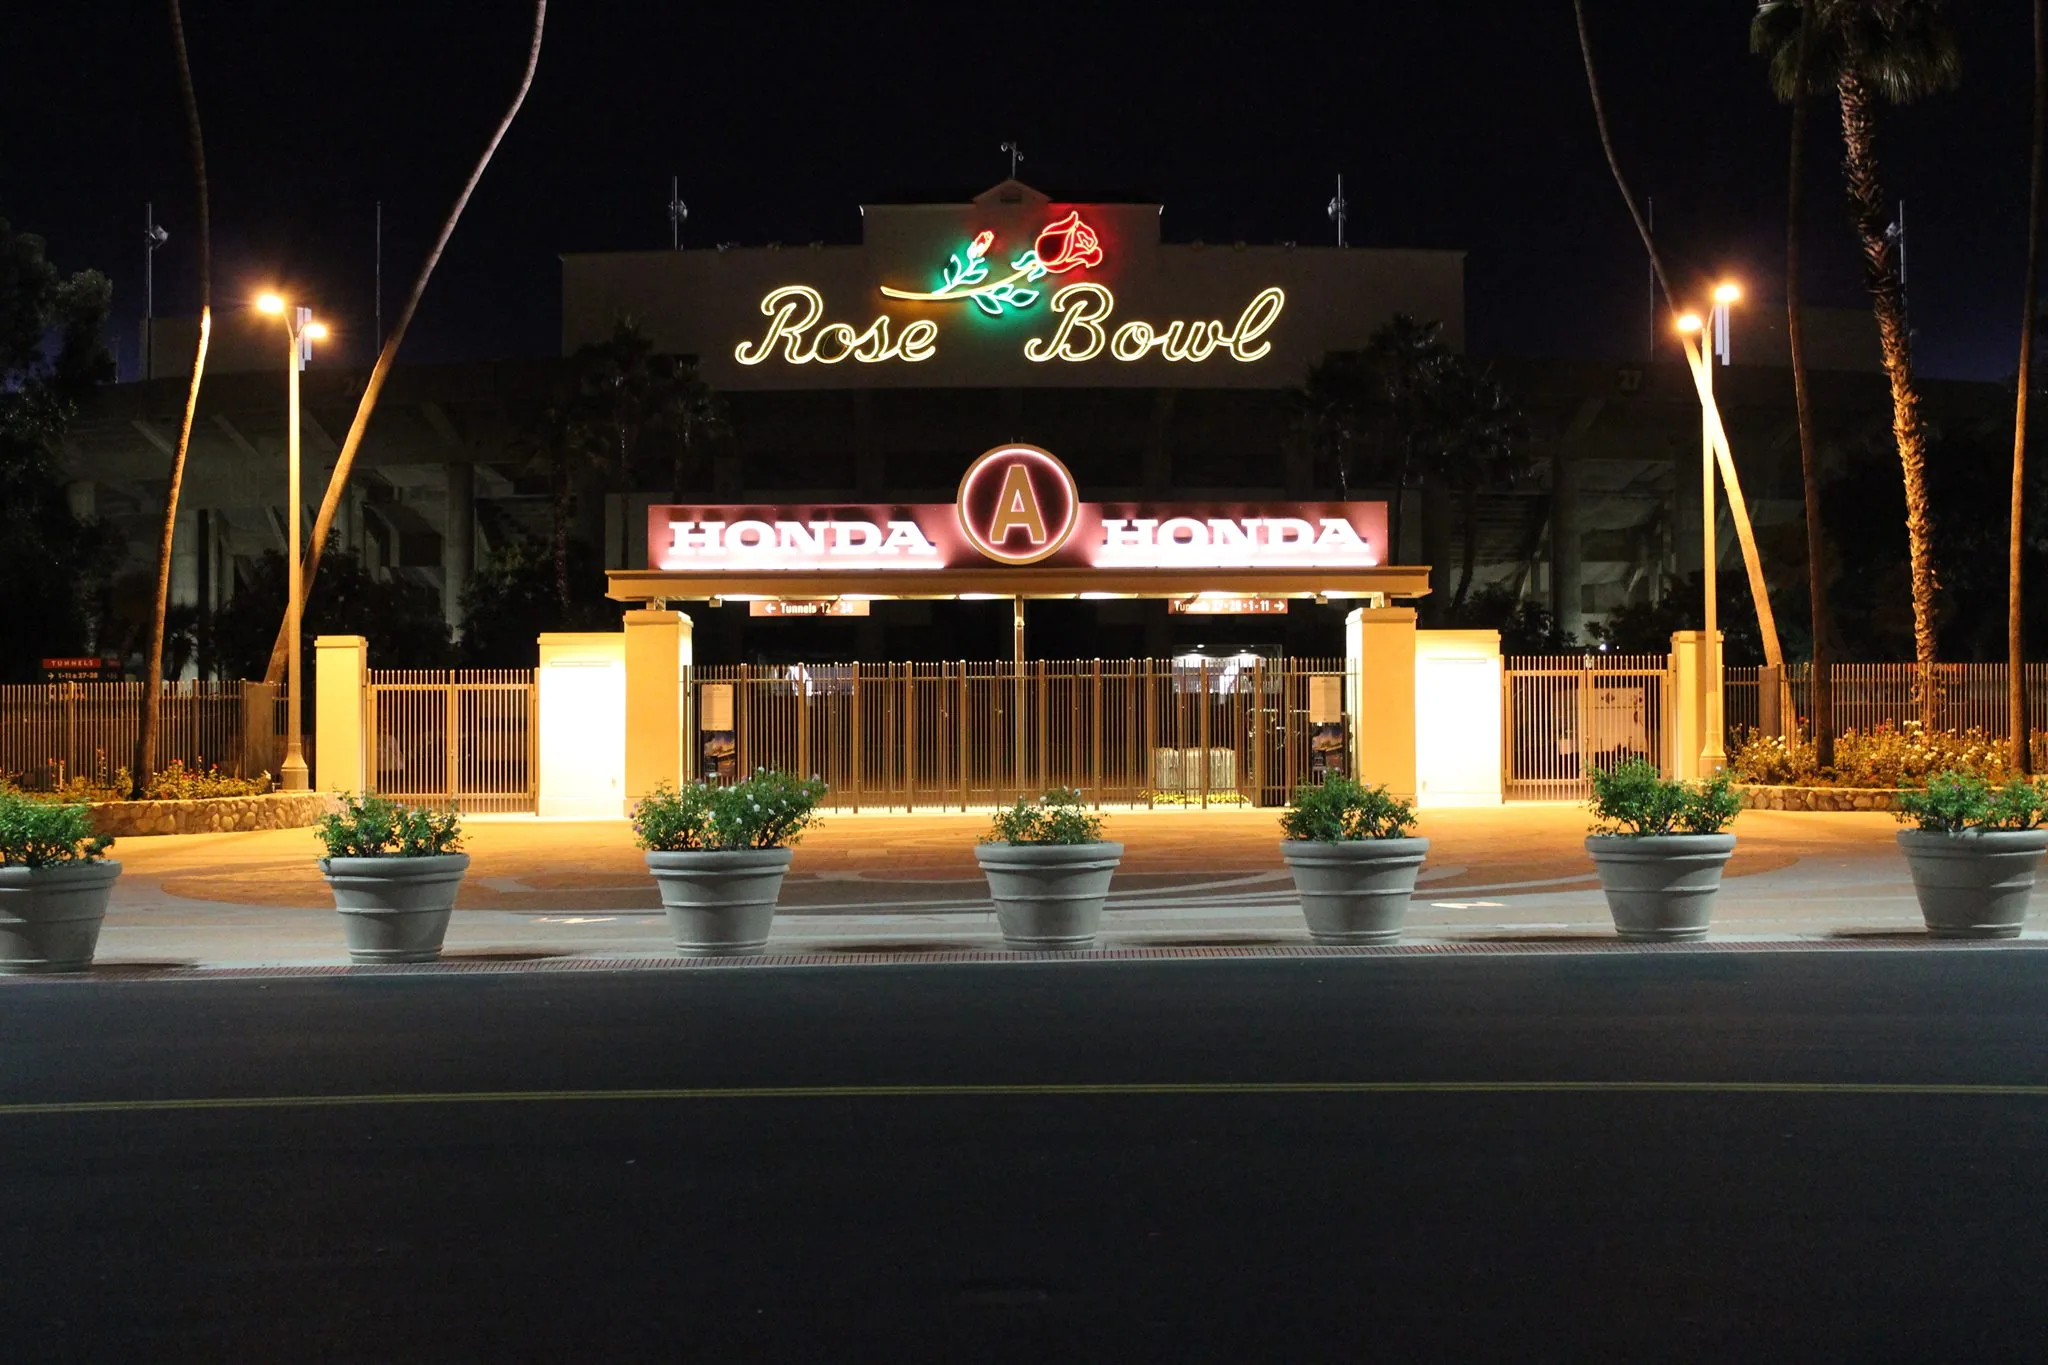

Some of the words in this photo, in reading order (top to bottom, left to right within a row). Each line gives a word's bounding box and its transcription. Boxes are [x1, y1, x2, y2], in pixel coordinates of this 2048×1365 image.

[735, 285, 939, 366] Rose
[1024, 282, 1285, 363] Bowl
[989, 464, 1047, 544] A
[668, 520, 938, 555] HONDA
[1101, 518, 1371, 553] HONDA
[780, 602, 817, 614] Tunnels
[51, 659, 94, 667] TUNNELS
